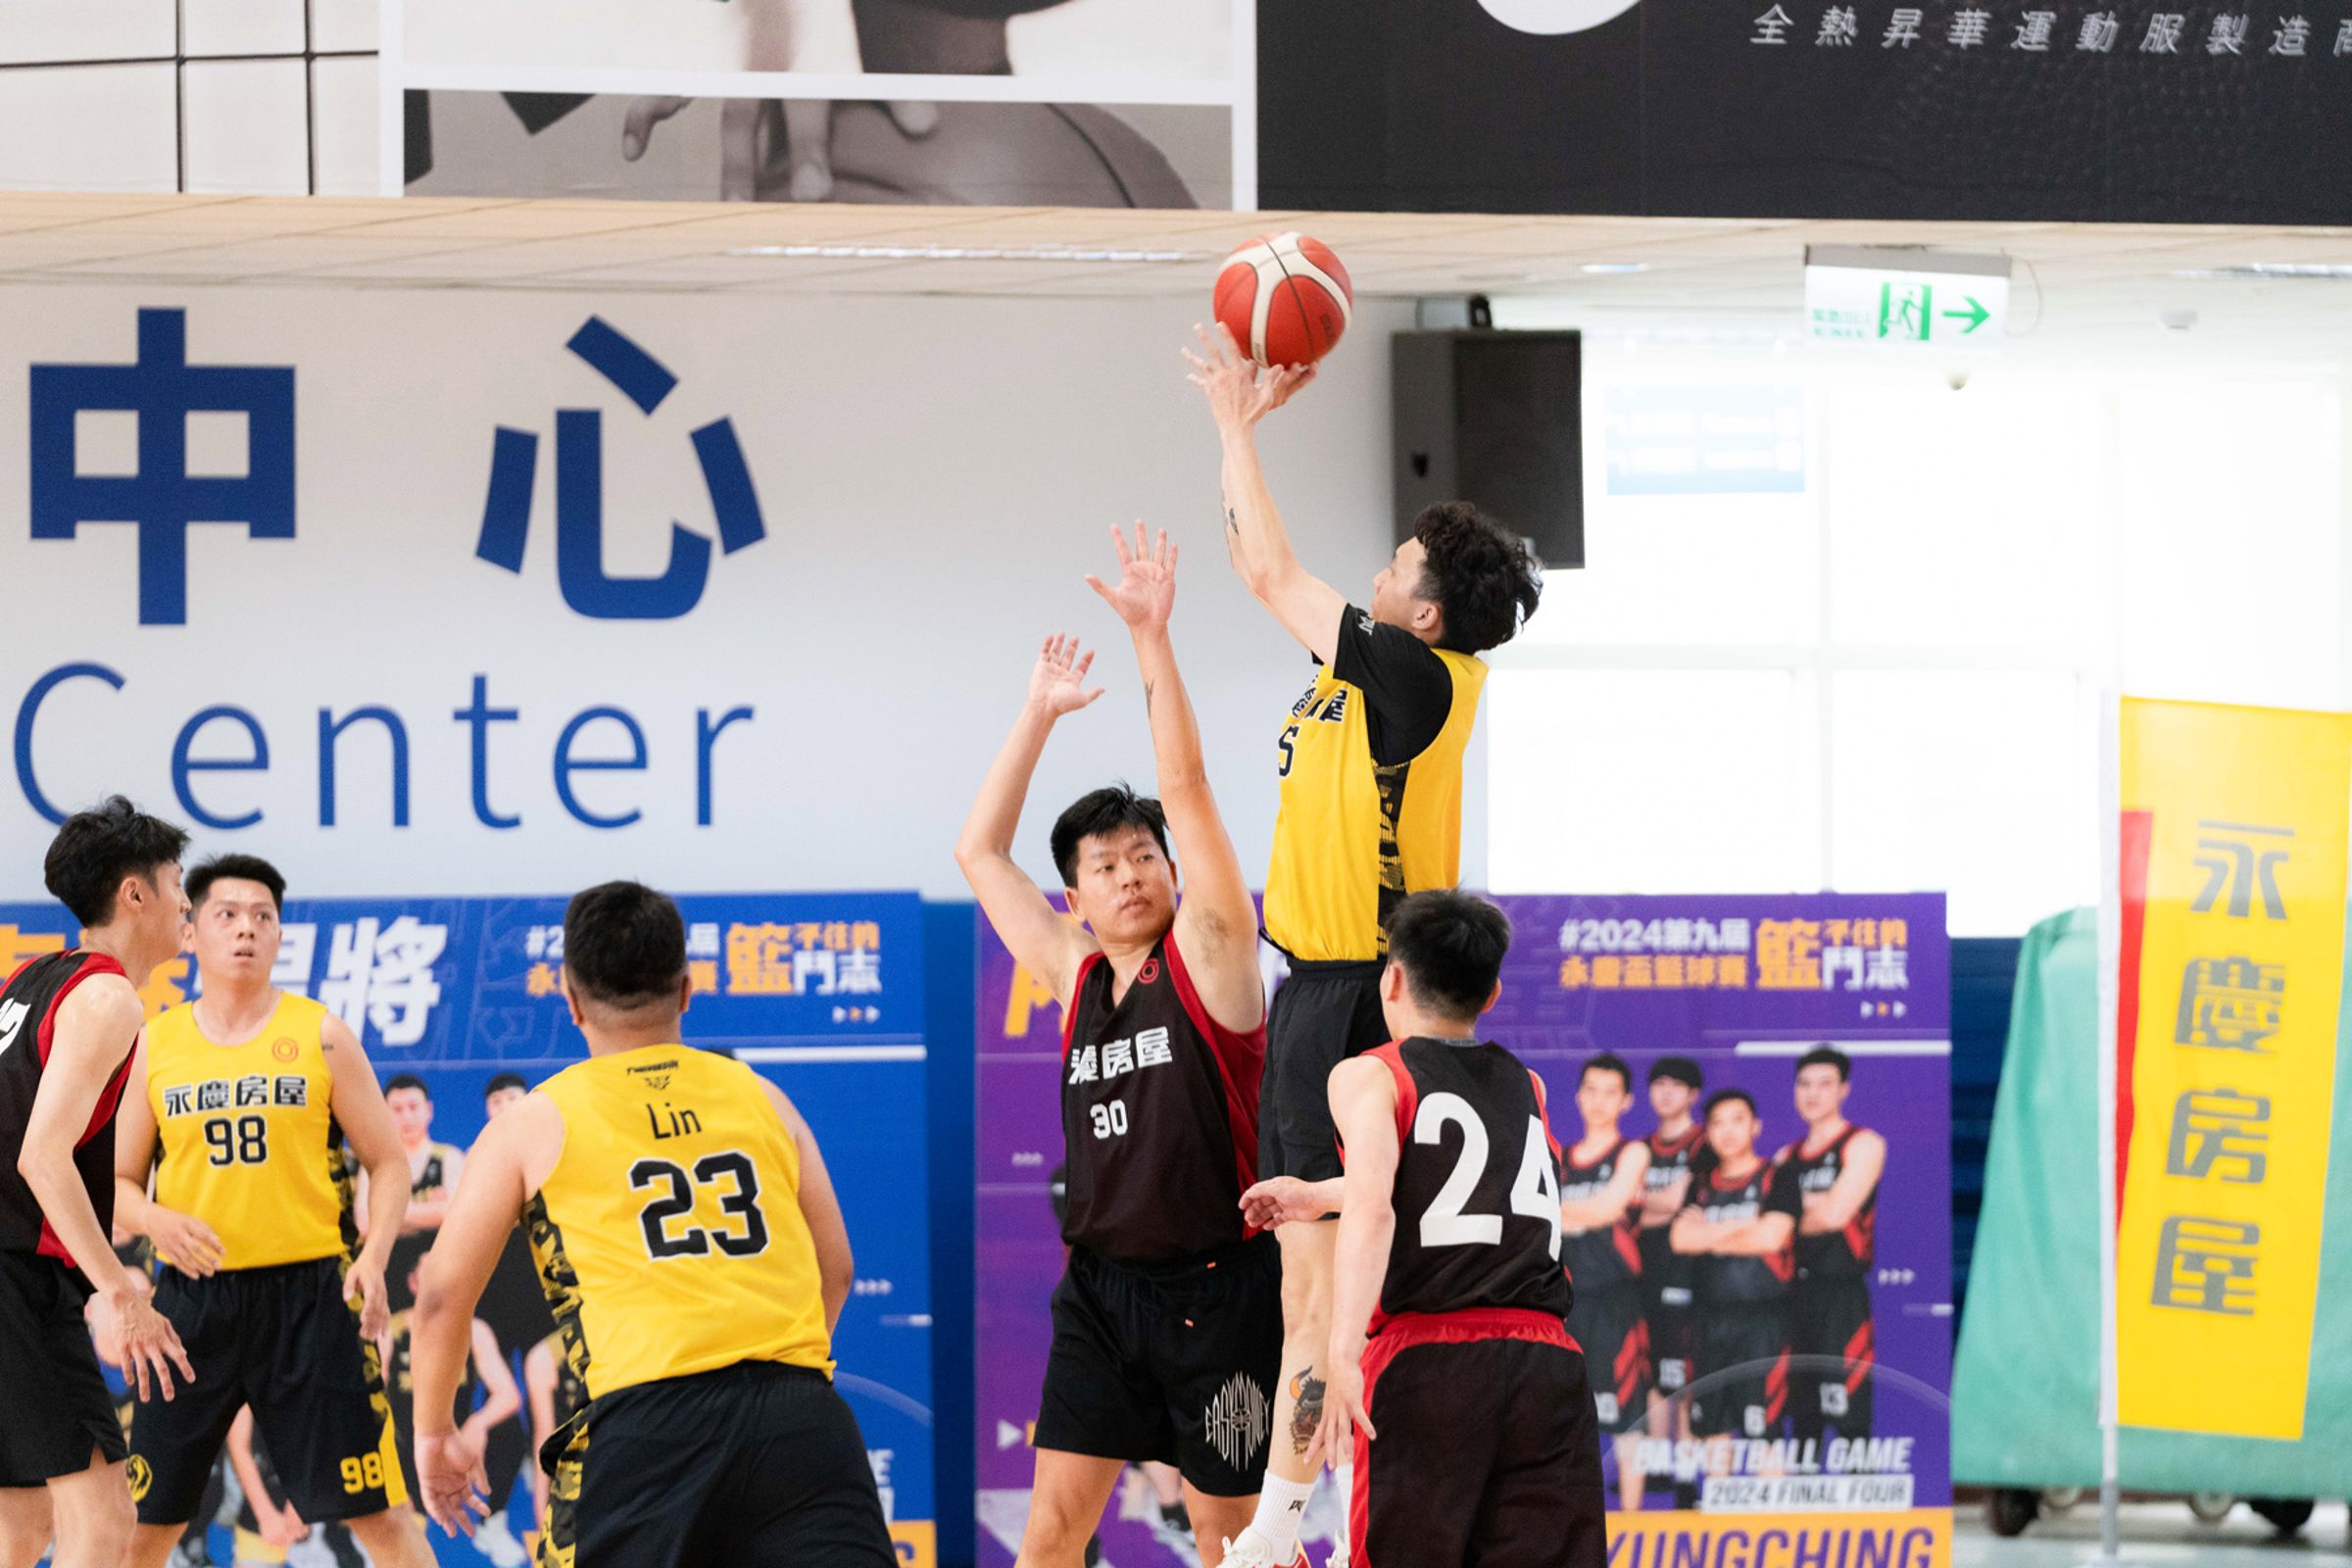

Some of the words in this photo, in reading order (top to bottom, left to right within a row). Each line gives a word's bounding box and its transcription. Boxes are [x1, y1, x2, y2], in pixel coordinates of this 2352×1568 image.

[29, 307, 767, 625] 中心
[14, 661, 755, 830] Center
[2151, 819, 2295, 1316] 永慶房屋
[164, 1075, 308, 1117] 永慶房屋
[1090, 1099, 1128, 1140] 30
[203, 1114, 269, 1167] 98
[646, 1102, 703, 1140] Lin
[1414, 1092, 1563, 1262] 24
[628, 1149, 770, 1262] 23
[339, 1451, 385, 1494] 98
[1634, 1437, 1822, 1475] BASKETBALL
[1826, 1437, 1915, 1473] GAME
[1710, 1479, 1769, 1505] 2024
[1777, 1478, 1838, 1504] FINAL
[1847, 1477, 1906, 1503] FOUR
